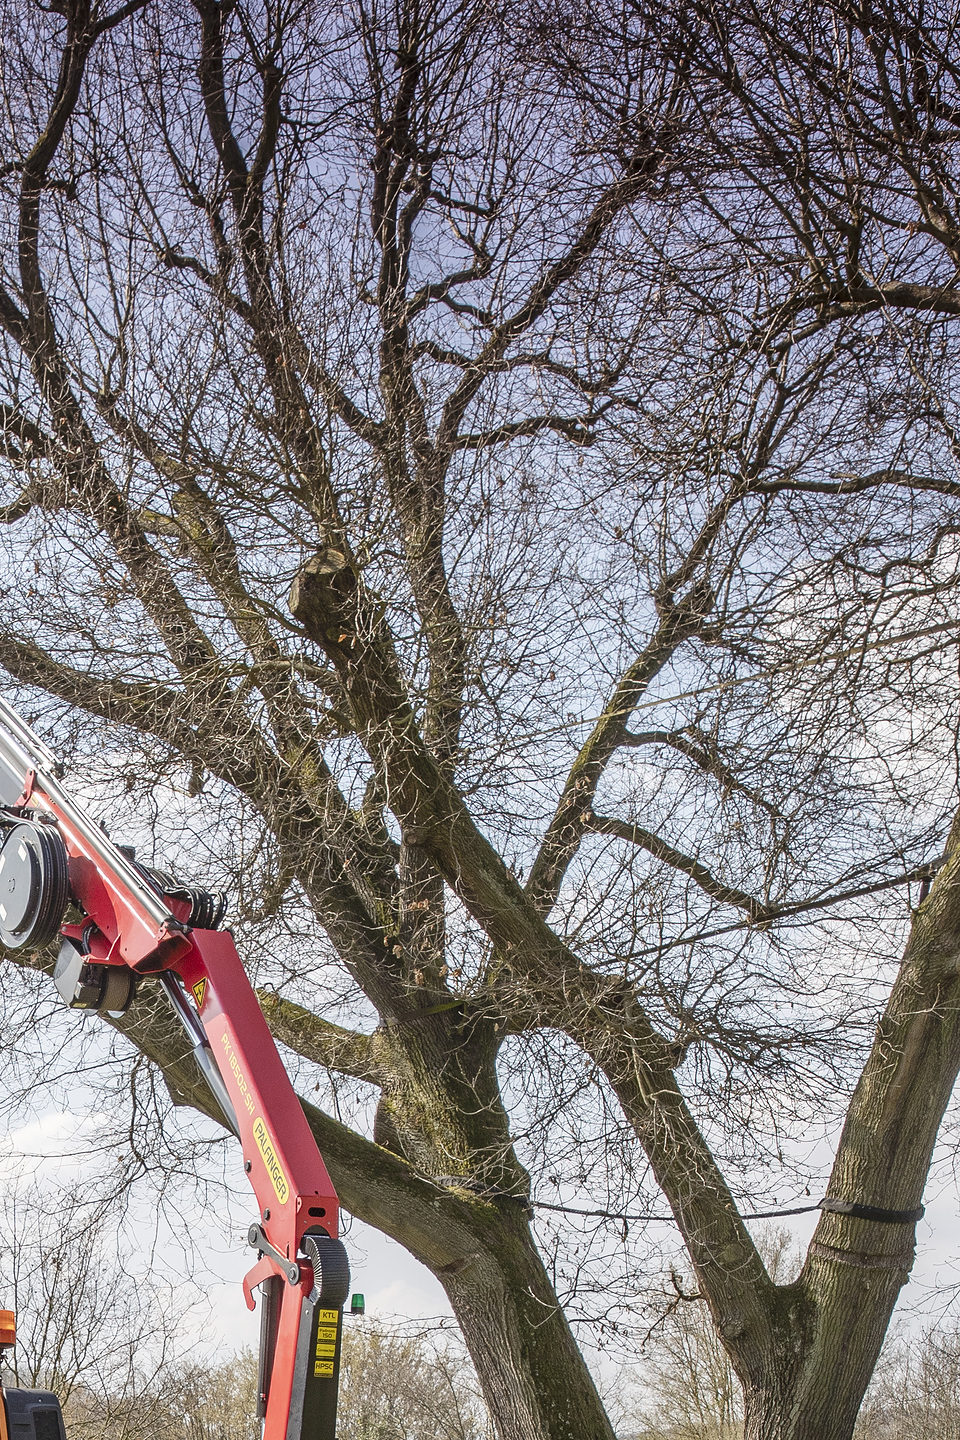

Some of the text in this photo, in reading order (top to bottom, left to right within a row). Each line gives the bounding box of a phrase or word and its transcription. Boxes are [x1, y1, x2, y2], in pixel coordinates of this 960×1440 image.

[221, 1032, 232, 1056] PK
[254, 1122, 287, 1200] PALFINGER
[322, 1311, 336, 1319] KTL
[315, 1362, 333, 1370] HPSC
